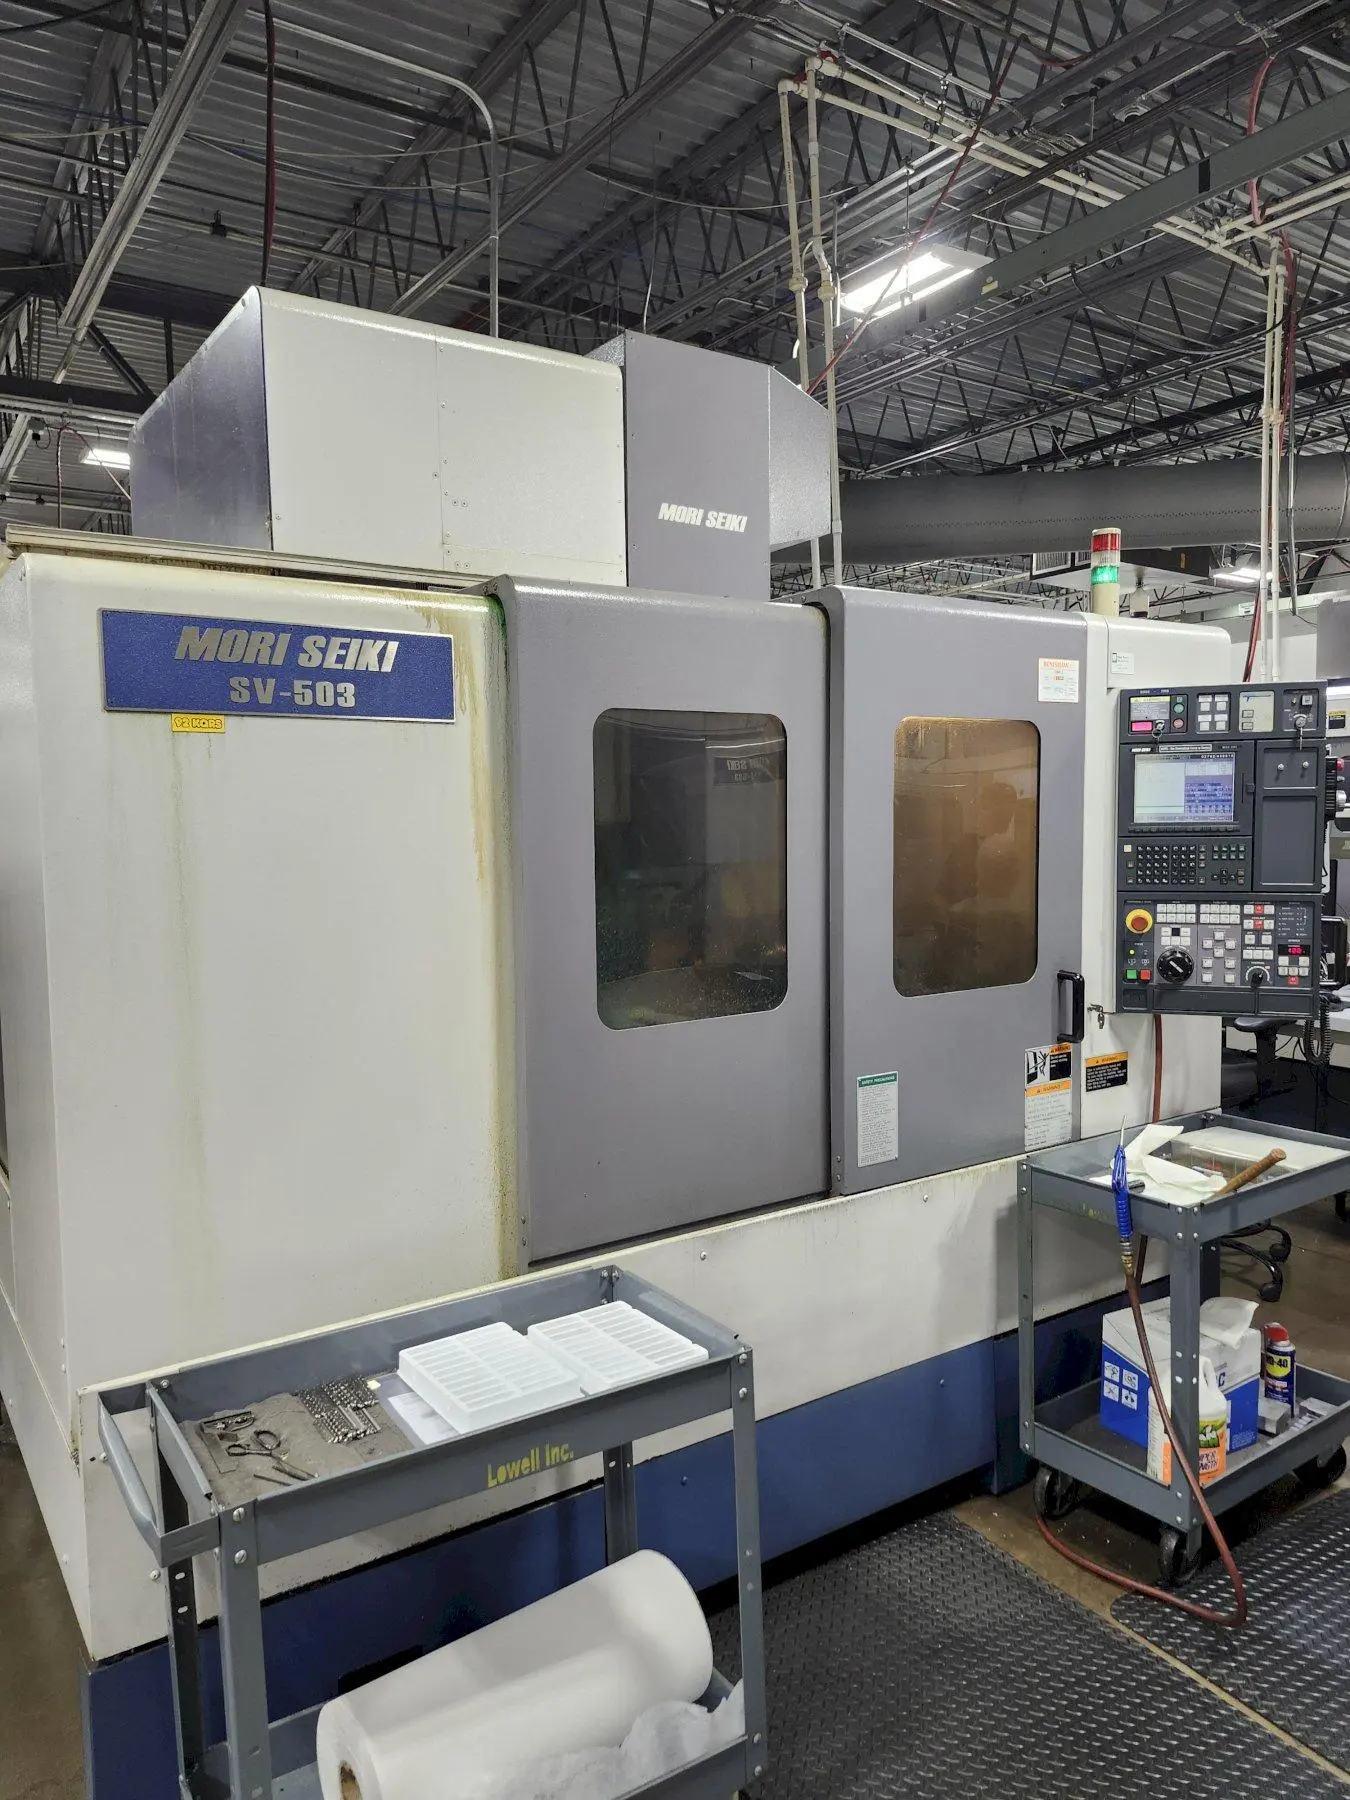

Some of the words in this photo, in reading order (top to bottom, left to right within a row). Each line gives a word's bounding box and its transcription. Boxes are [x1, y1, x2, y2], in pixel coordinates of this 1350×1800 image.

[658, 502, 704, 526] MORI
[705, 510, 748, 533] SEIKI
[174, 625, 291, 666] MORI
[297, 635, 400, 673] SEIKI
[228, 676, 356, 708] SV-503
[486, 1446, 541, 1488] Lowell
[544, 1443, 574, 1467] Inc.
